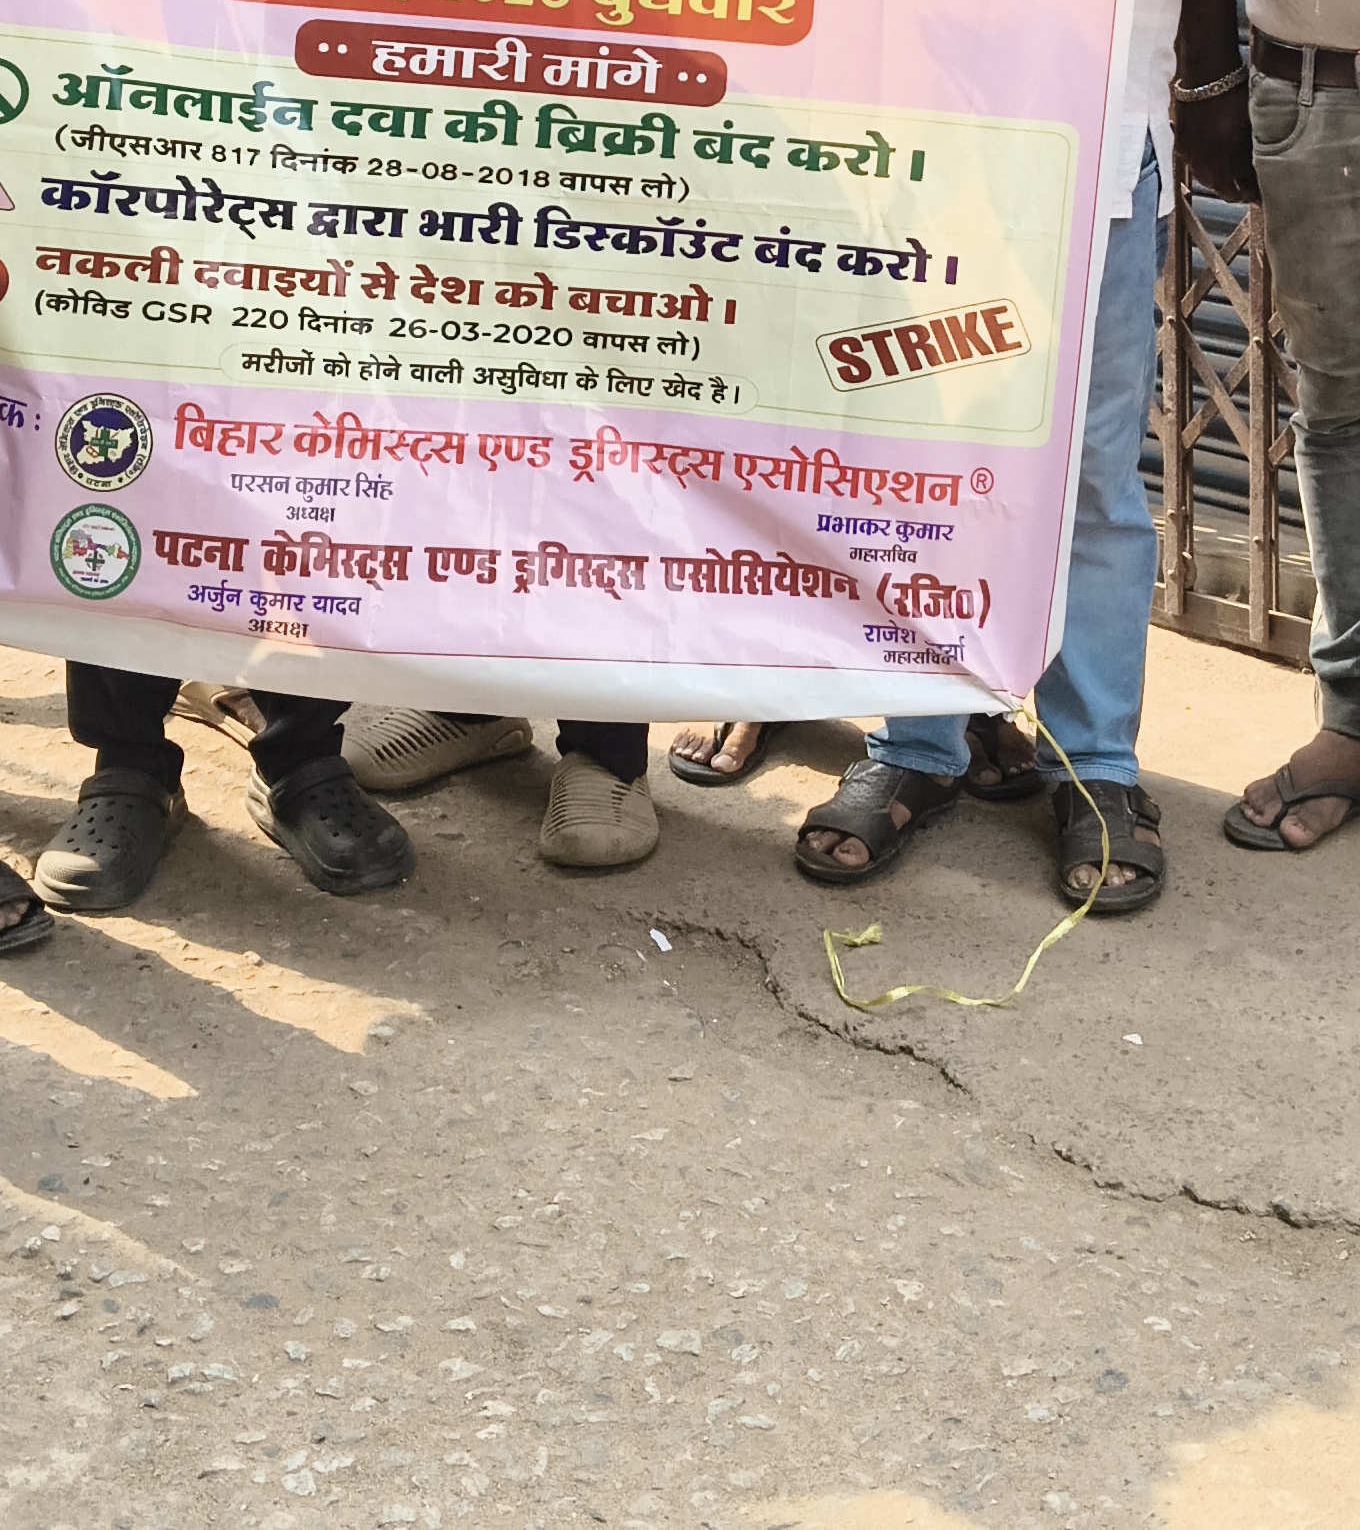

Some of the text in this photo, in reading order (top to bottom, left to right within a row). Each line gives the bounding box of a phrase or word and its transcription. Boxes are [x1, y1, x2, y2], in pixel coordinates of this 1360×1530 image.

[372, 37, 663, 96] हमारी मांगे
[51, 63, 320, 133] ऑनलाईन
[331, 99, 433, 140] दवा
[444, 100, 523, 146] की
[693, 119, 774, 169] बंद
[212, 146, 261, 167] 817
[270, 145, 360, 176] दिनांक
[367, 157, 551, 191] 28-08-2018
[559, 172, 633, 198] वापस
[40, 169, 298, 240] कॉरपोरेट्स
[307, 201, 409, 240] द्वारा
[418, 202, 523, 249] भारी
[754, 225, 827, 273] बंद
[36, 245, 184, 285] नकली
[194, 258, 354, 298] दवाइयों
[360, 262, 401, 302] से
[410, 261, 483, 307] देश
[495, 272, 559, 311] को
[141, 301, 214, 326] GSR
[231, 306, 289, 331] 220
[298, 309, 373, 336] दिनांक
[388, 316, 575, 349] 26-03-2020
[582, 331, 650, 356] वापस
[827, 304, 1024, 386] STRIKE
[241, 349, 316, 377] मरीजों
[323, 353, 351, 379] को
[358, 354, 402, 382] होने
[410, 357, 463, 384] वाली
[474, 364, 567, 394] असुविधा
[575, 367, 599, 392] के
[606, 368, 653, 397] लिए
[661, 376, 704, 402] खेद
[173, 402, 286, 457] बिहार
[294, 411, 469, 477] केमिस्ट्स
[477, 432, 554, 472] एण्ड
[569, 425, 725, 489] ड्रगिस्ट्स
[733, 446, 963, 507] एसोसिएशन
[231, 472, 394, 503] परसन कुमार सिंह
[816, 513, 955, 545] प्रभाकर कुमार
[152, 529, 258, 574] पटना
[263, 529, 413, 591] केमिस्ट्स
[424, 545, 502, 585] एण्ड
[512, 541, 650, 601] ड्रगिस्ट्स
[661, 547, 861, 602] एसोसियेशन
[187, 580, 363, 618] अर्जुन कुमार यादव
[863, 620, 916, 644] राजेश
